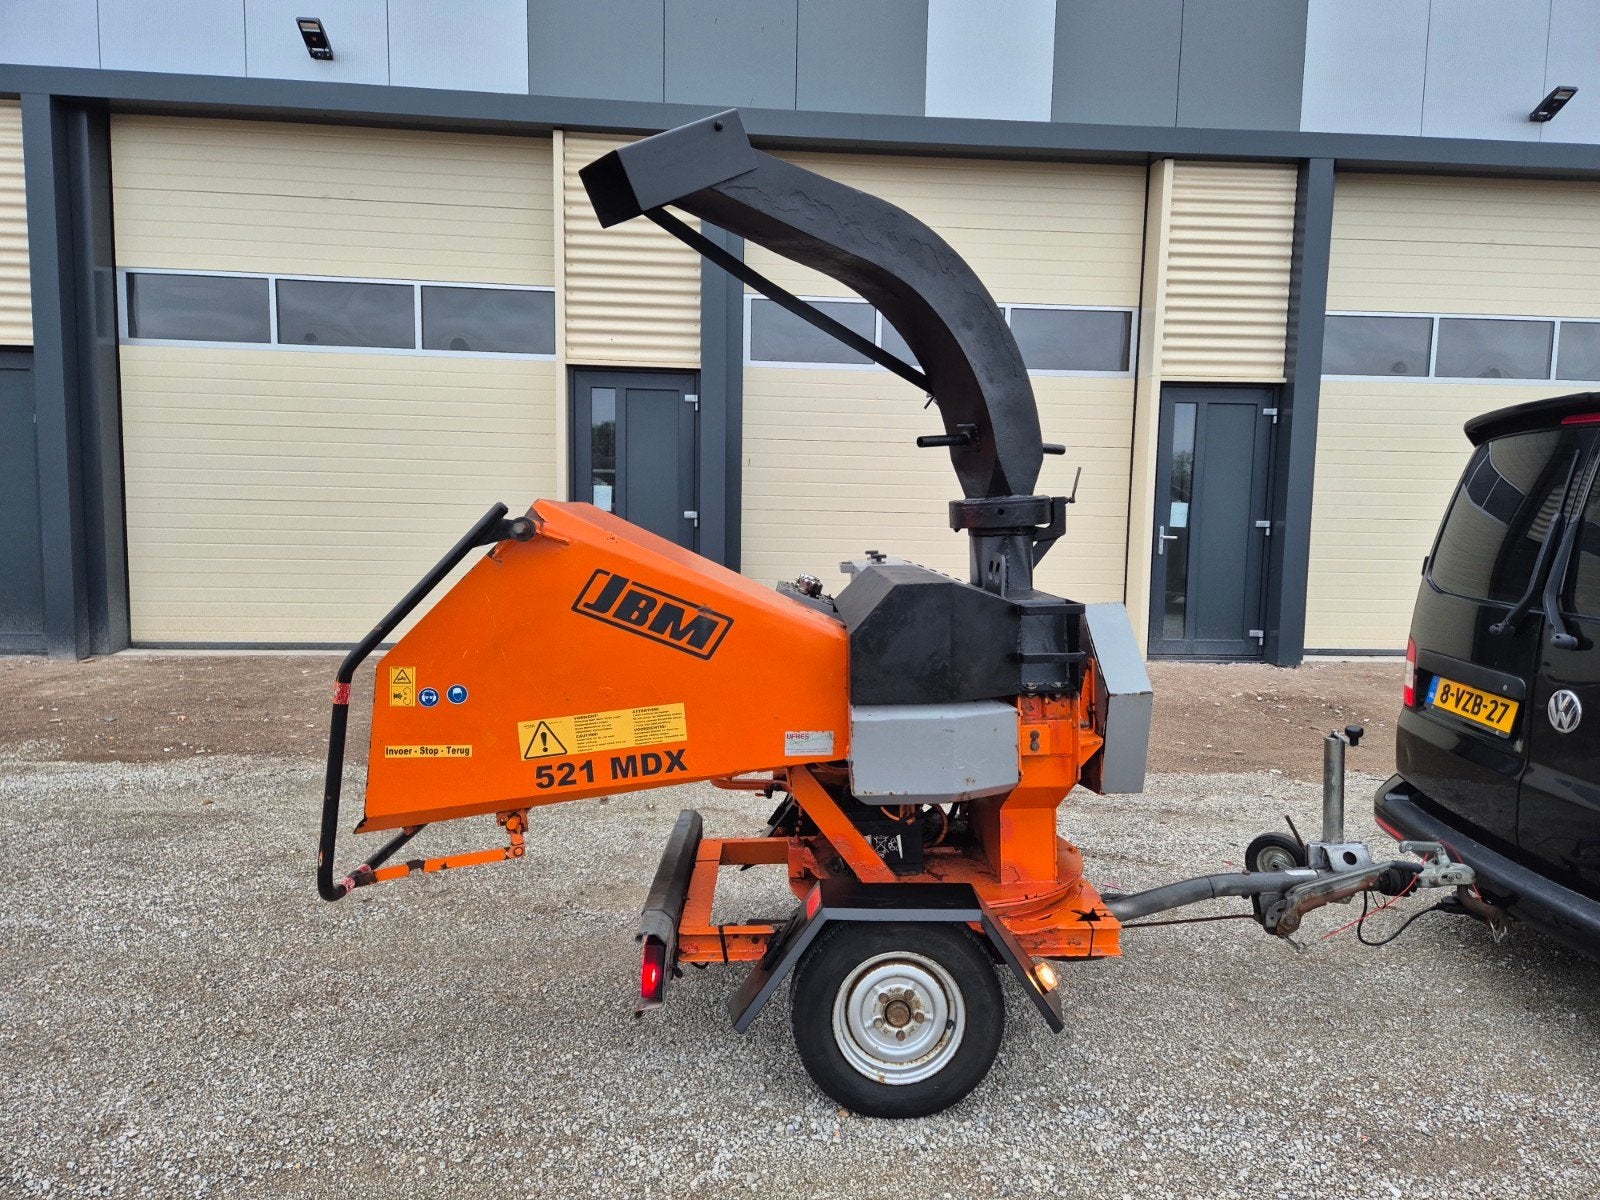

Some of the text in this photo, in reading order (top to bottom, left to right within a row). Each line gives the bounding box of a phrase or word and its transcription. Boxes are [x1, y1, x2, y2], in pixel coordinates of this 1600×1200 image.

[582, 572, 721, 651] JBM
[1438, 683, 1510, 724] 8-VZB-27
[386, 746, 470, 756] Invoer Stop Terug
[535, 748, 688, 789] 521 MDX
